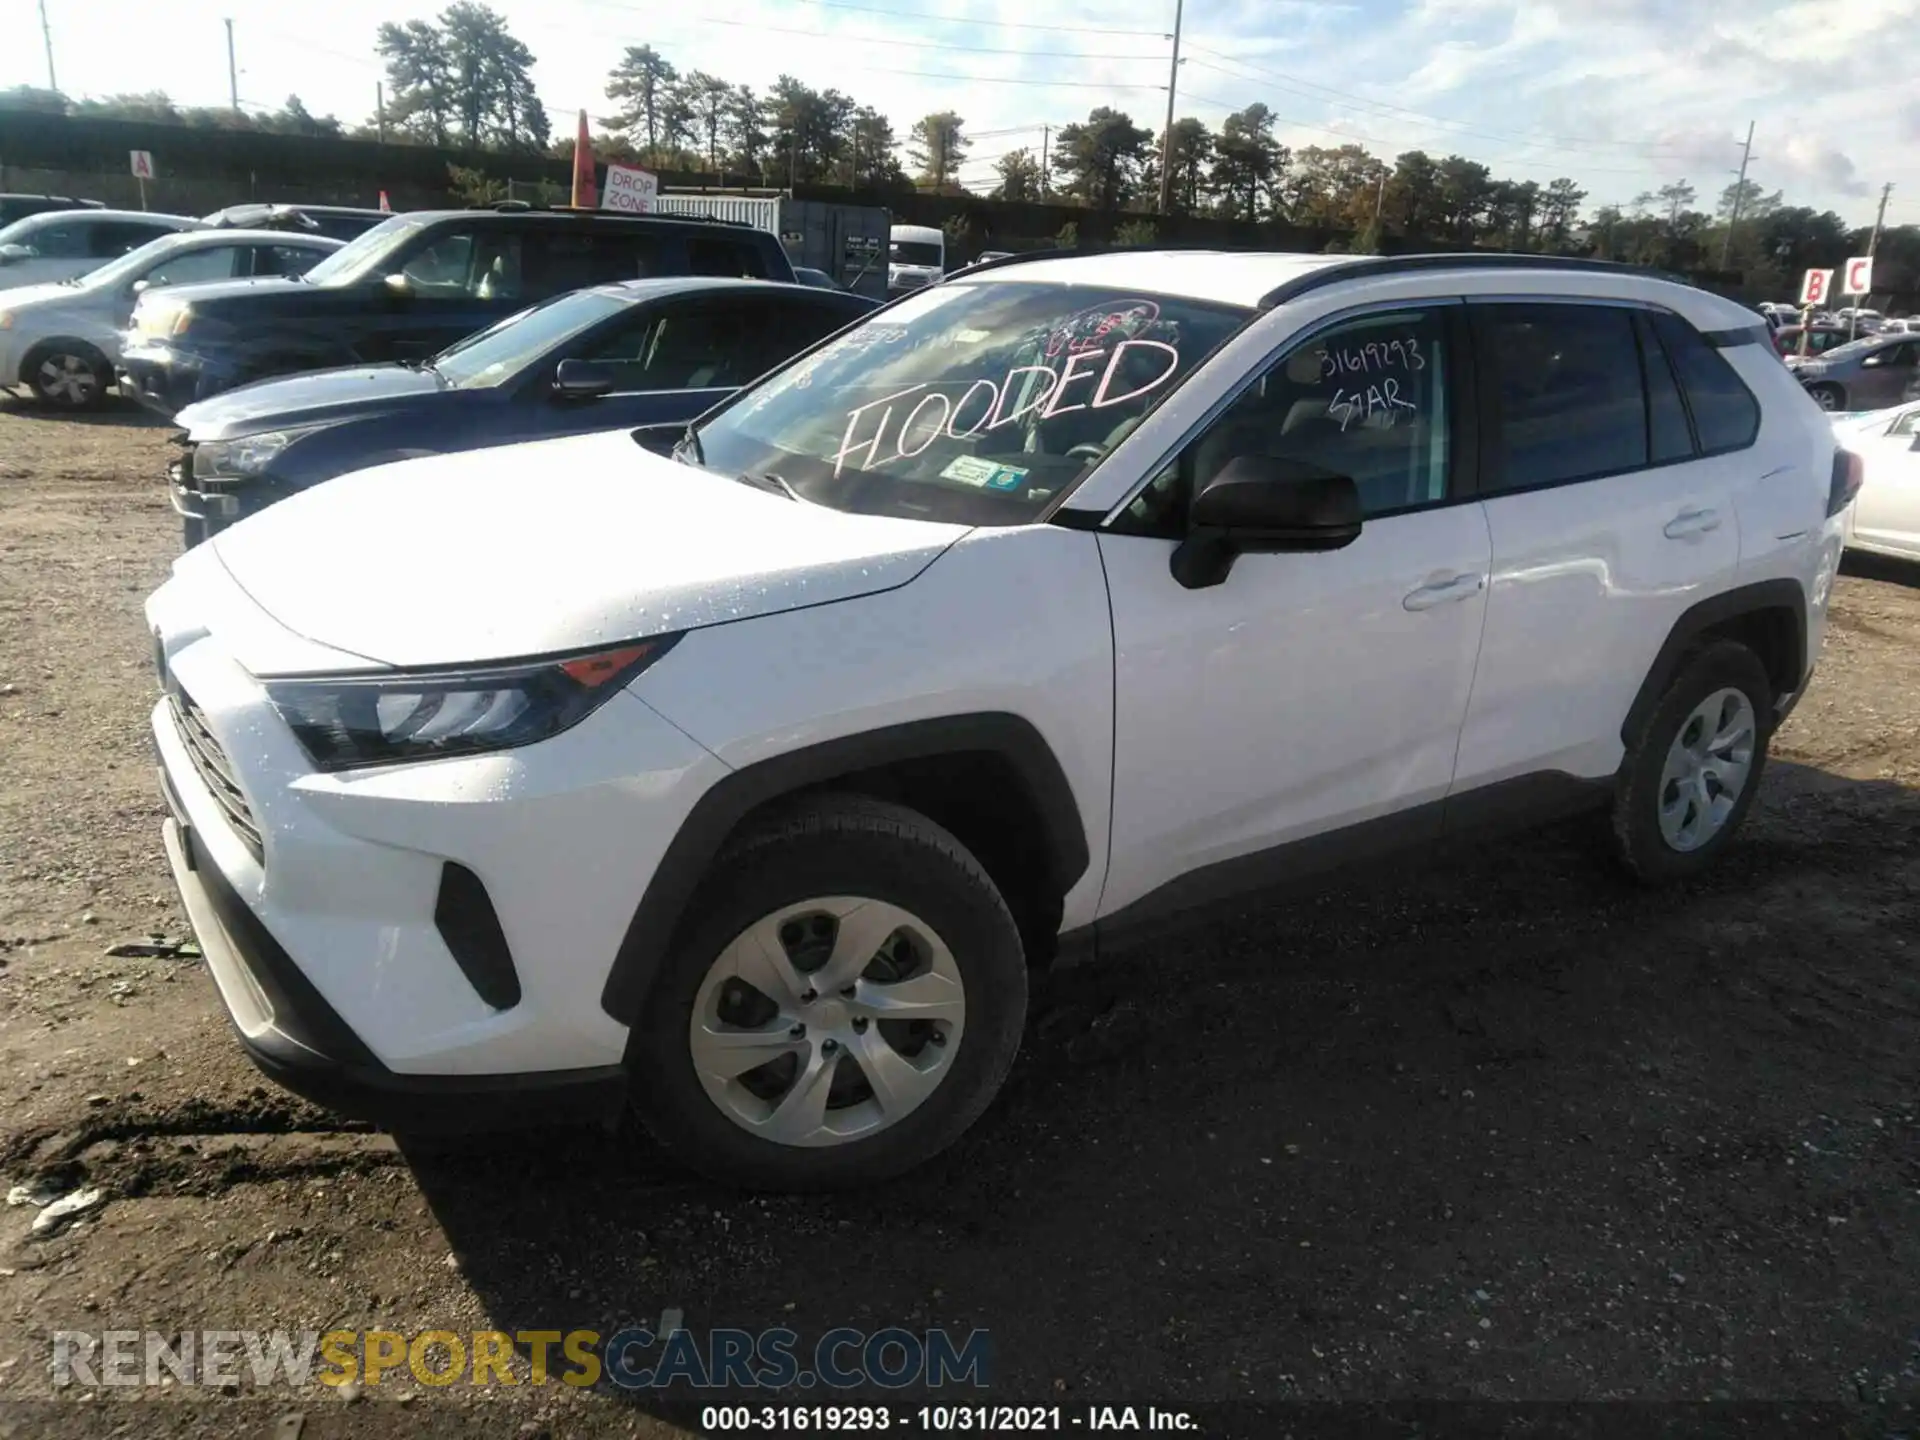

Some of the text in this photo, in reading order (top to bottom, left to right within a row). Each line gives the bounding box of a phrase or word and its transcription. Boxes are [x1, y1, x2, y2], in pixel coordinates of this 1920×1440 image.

[136, 152, 149, 177] A
[611, 171, 653, 194] DROP
[609, 190, 649, 212] ZONE
[1806, 271, 1824, 301] B
[1850, 262, 1867, 290] C
[1314, 338, 1425, 376] 31619293
[832, 340, 1178, 480] FLOODED
